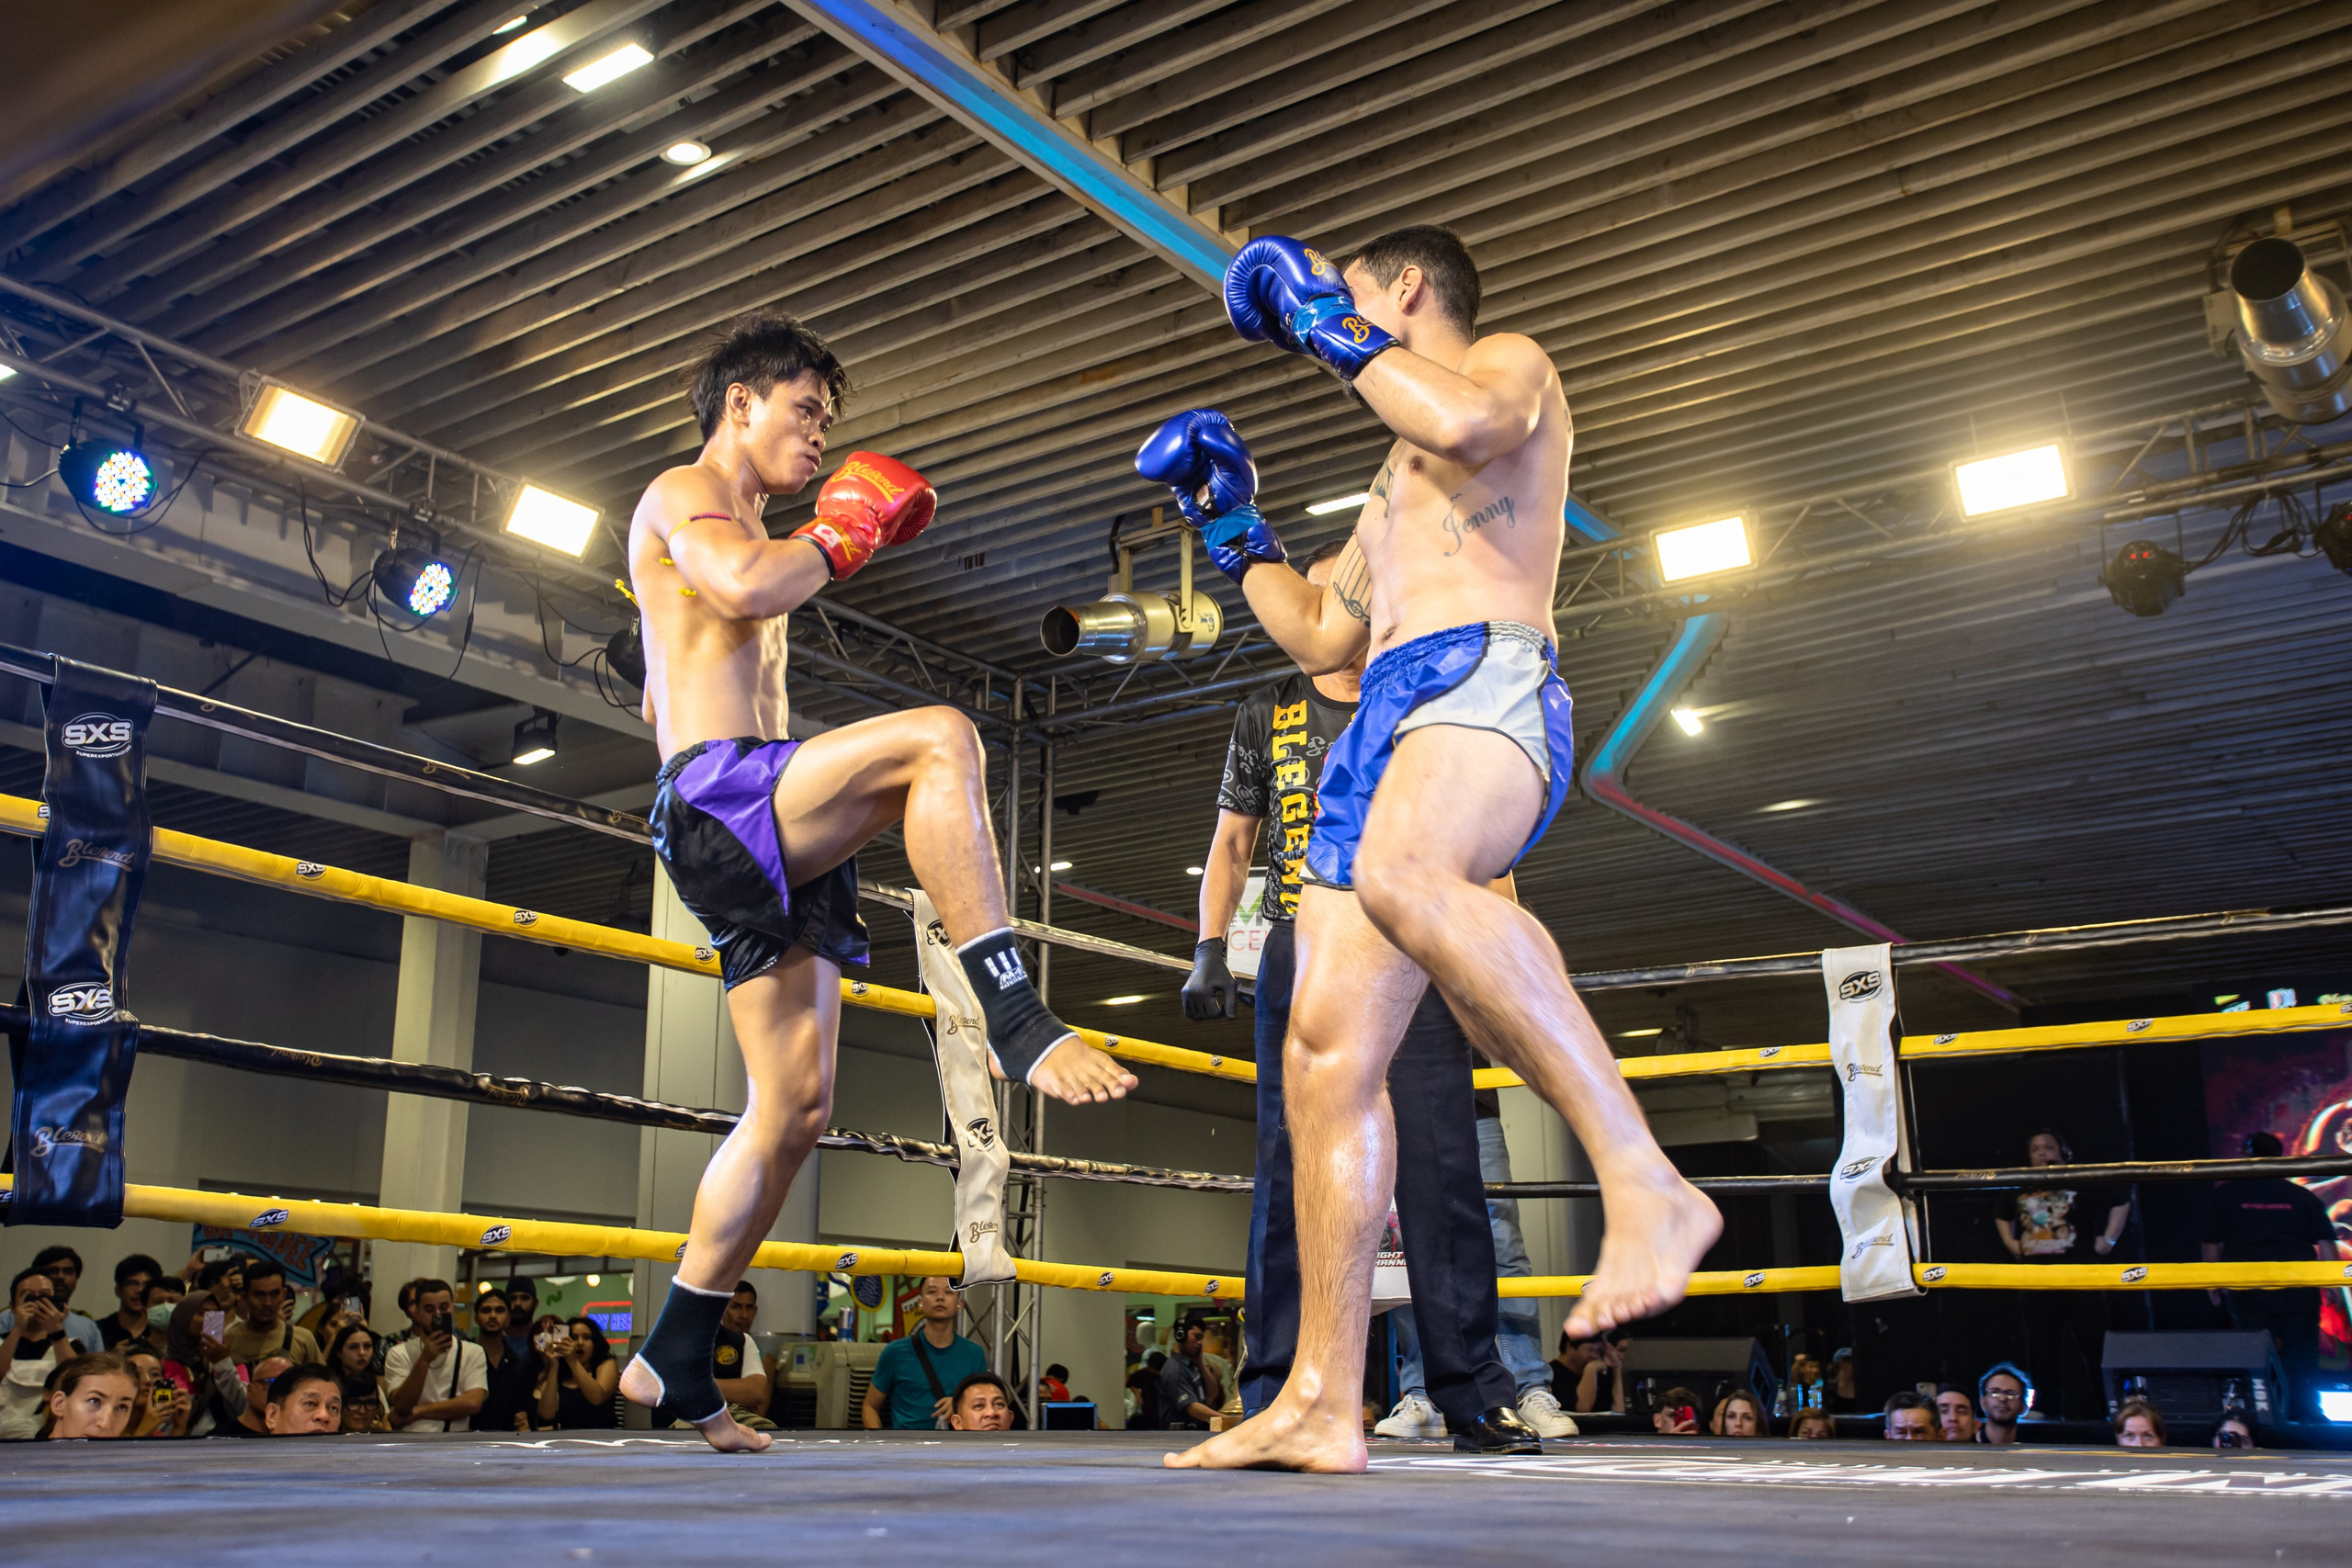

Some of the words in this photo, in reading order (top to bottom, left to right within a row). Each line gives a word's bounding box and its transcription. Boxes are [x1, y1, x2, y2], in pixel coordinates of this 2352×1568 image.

[831, 461, 905, 503] Blegend
[1443, 494, 1515, 557] Jenny
[64, 722, 131, 745] SXS
[58, 839, 135, 872] Blegend
[297, 863, 325, 874] SXS
[514, 911, 538, 923] SXS
[1229, 930, 1269, 951] CE
[695, 949, 715, 959] SXS
[1840, 972, 1882, 999] SXS
[51, 988, 113, 1014] SXS
[947, 1015, 980, 1035] Blegend
[1847, 1063, 1883, 1081] Blegend
[30, 1126, 106, 1157] Blegend
[1840, 1159, 1879, 1179] SXS
[252, 1211, 288, 1226] SXS
[481, 1226, 511, 1243] SXS
[969, 1221, 998, 1244] Blegen
[837, 1253, 858, 1268] SXS
[1098, 1272, 1114, 1285] SXS
[1744, 1273, 1765, 1287] SXS
[1923, 1267, 1946, 1282] SXS
[2121, 1267, 2147, 1282] SXS
[1205, 1280, 1218, 1292] SXS
